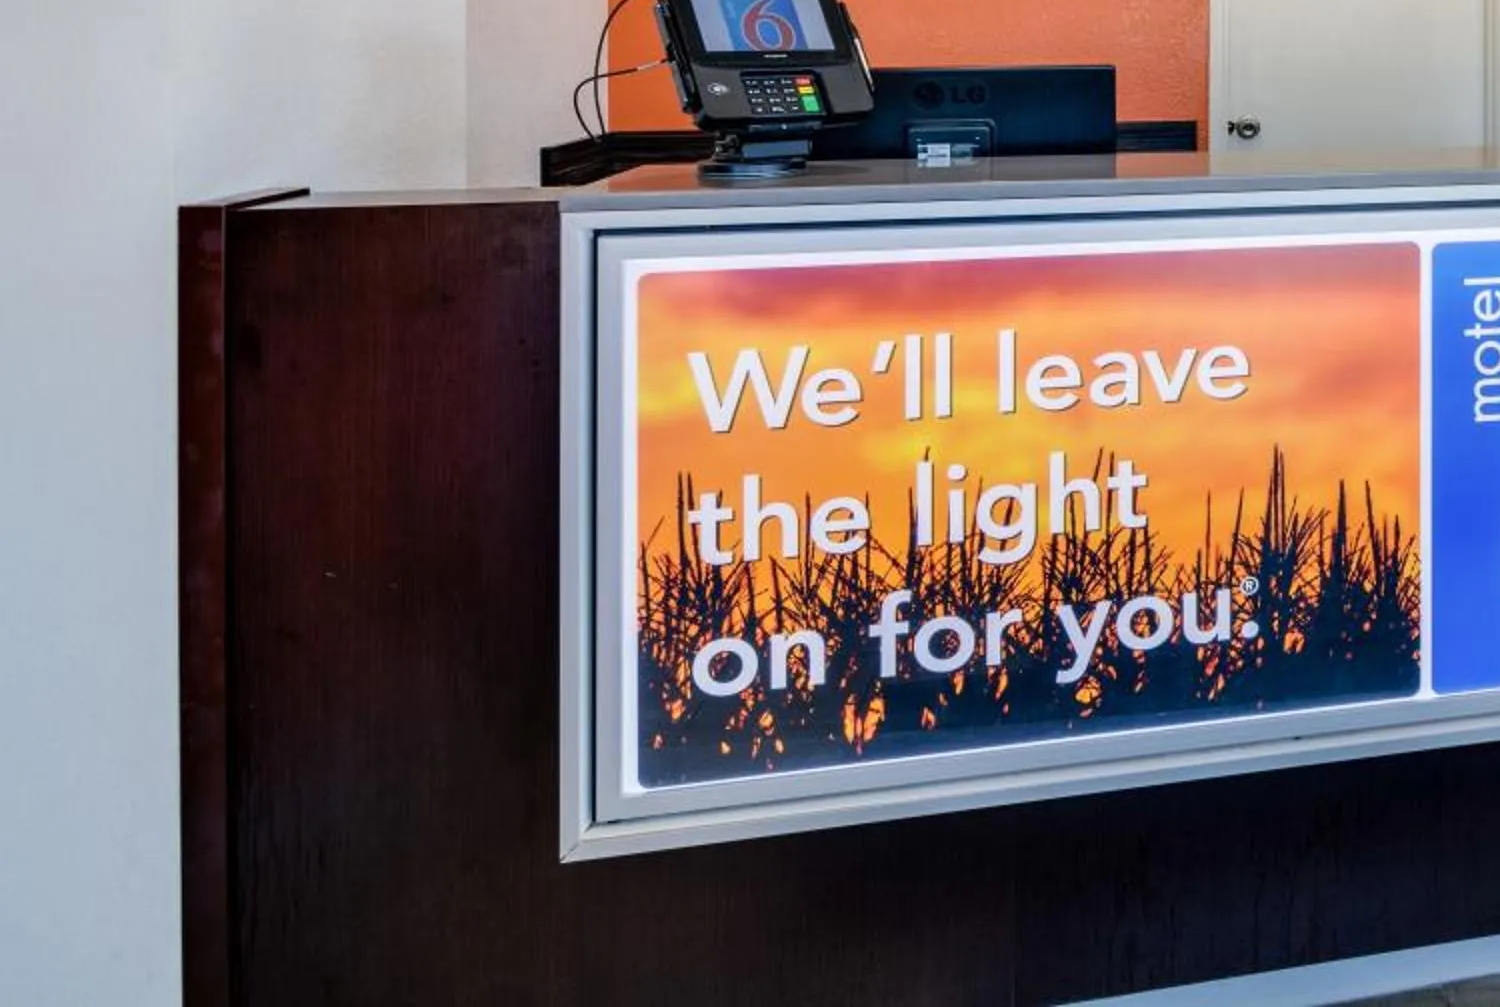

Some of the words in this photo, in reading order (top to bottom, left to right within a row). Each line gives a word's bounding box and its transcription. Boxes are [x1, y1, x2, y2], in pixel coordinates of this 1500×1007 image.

[948, 84, 987, 105] LG
[687, 332, 953, 433] We'll
[998, 328, 1251, 414] leave
[688, 474, 871, 566] the
[914, 450, 1149, 565] light
[691, 627, 827, 696] on
[869, 589, 1023, 679] for
[1054, 587, 1260, 685] you.
